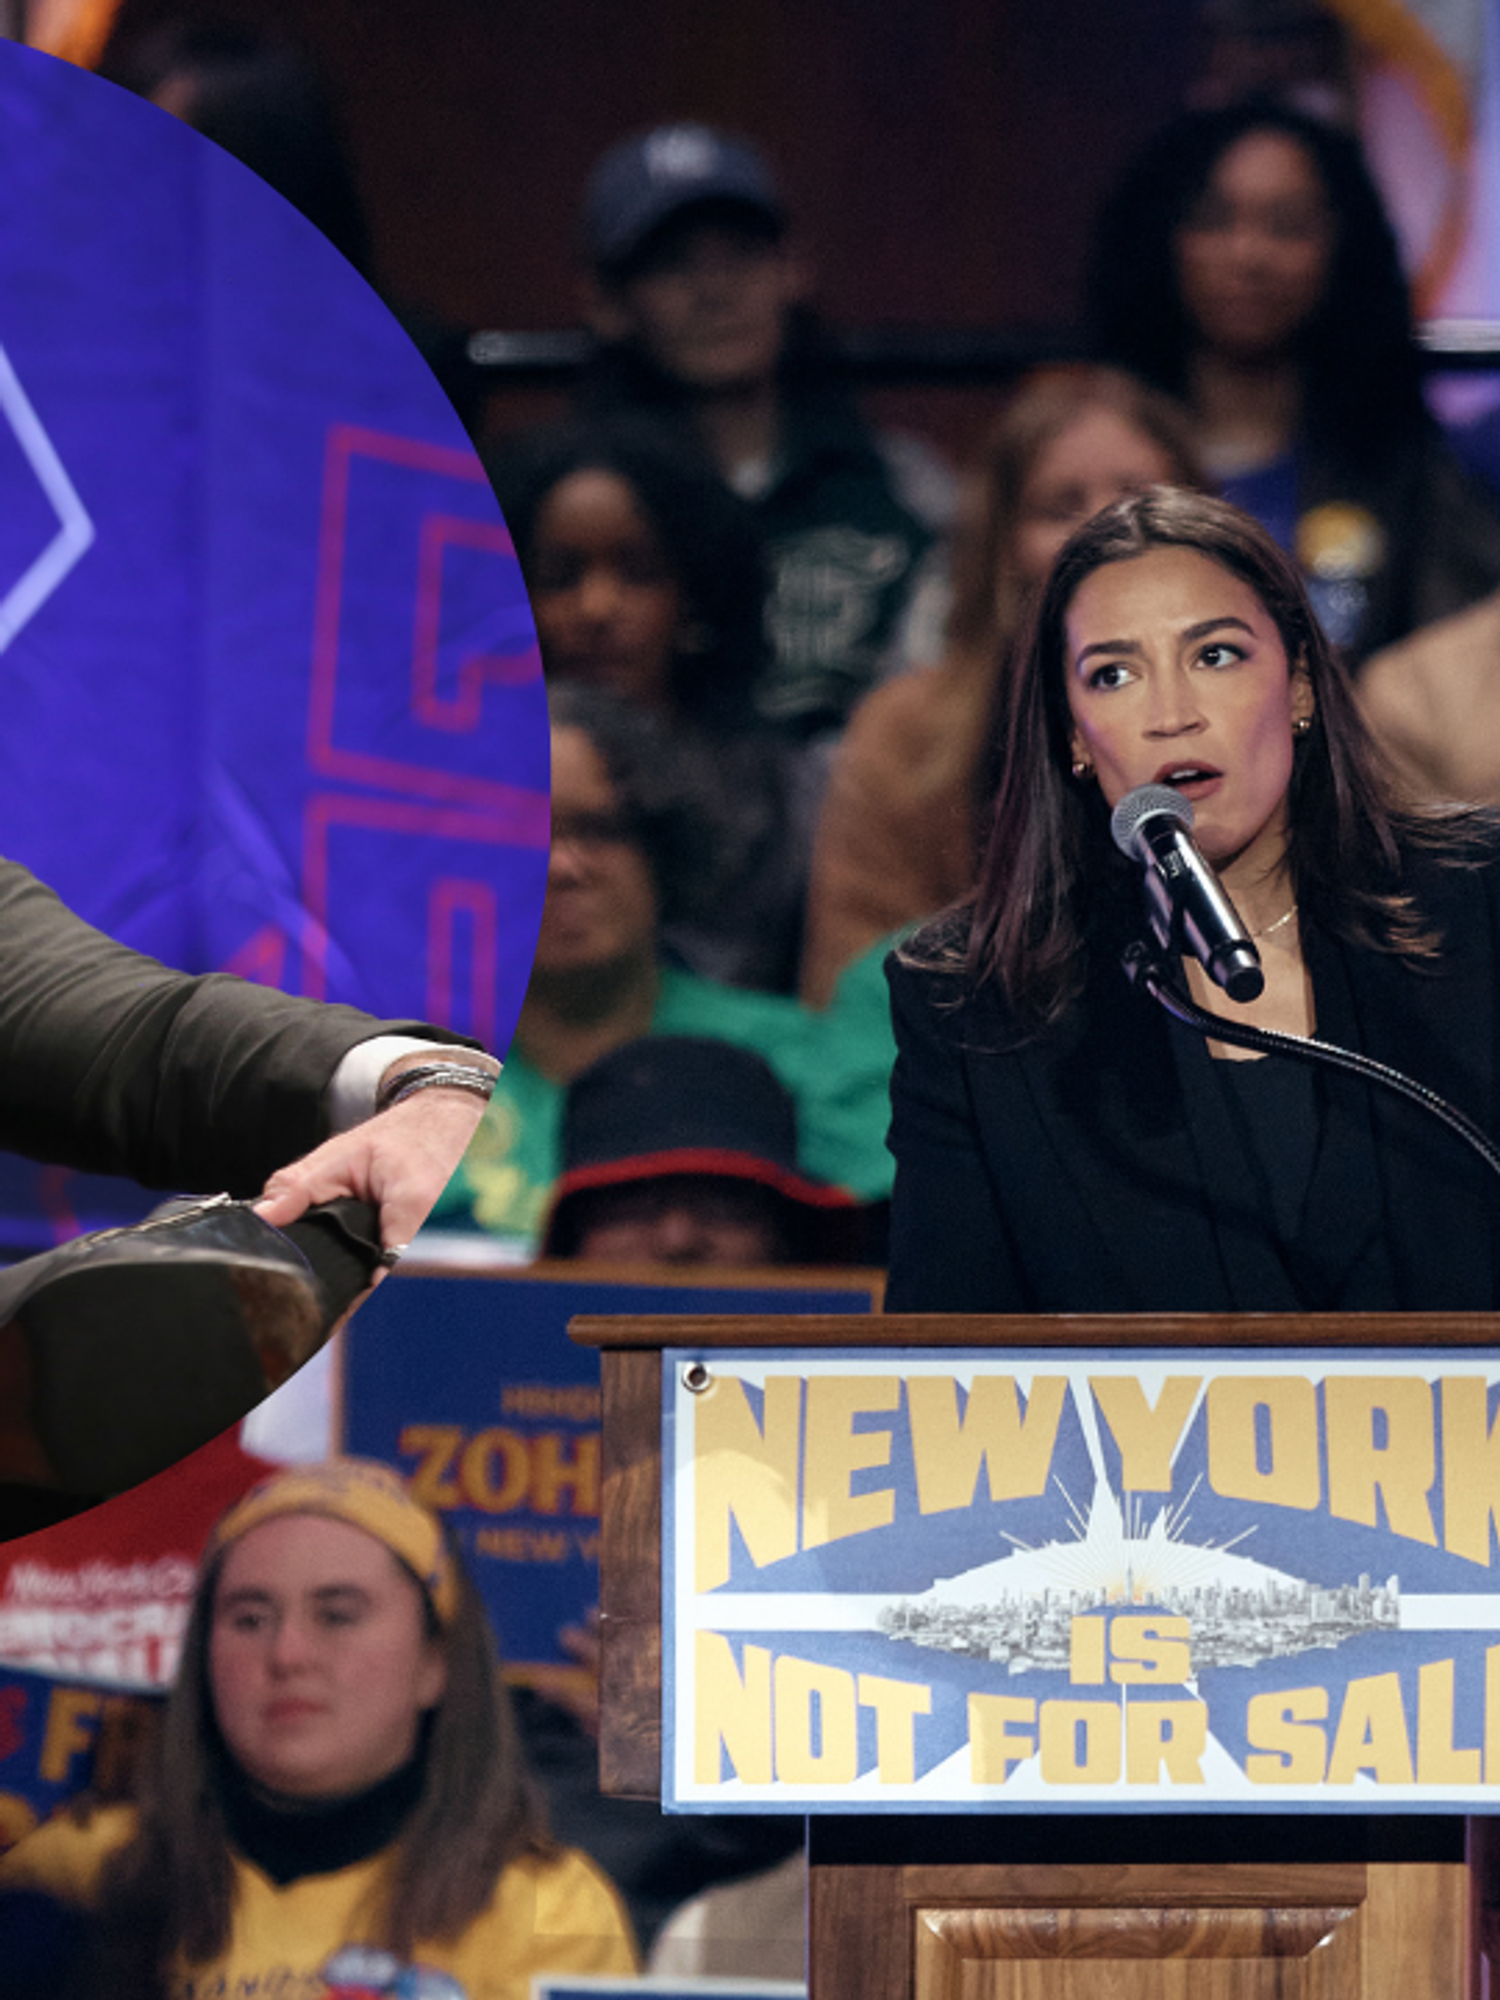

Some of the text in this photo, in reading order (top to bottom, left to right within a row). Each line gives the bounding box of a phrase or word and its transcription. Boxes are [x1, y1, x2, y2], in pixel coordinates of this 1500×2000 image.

[694, 1375, 1069, 1594] NEW
[694, 1629, 1500, 1785] NOT FOR SAL
[1070, 1615, 1192, 1685] IS
